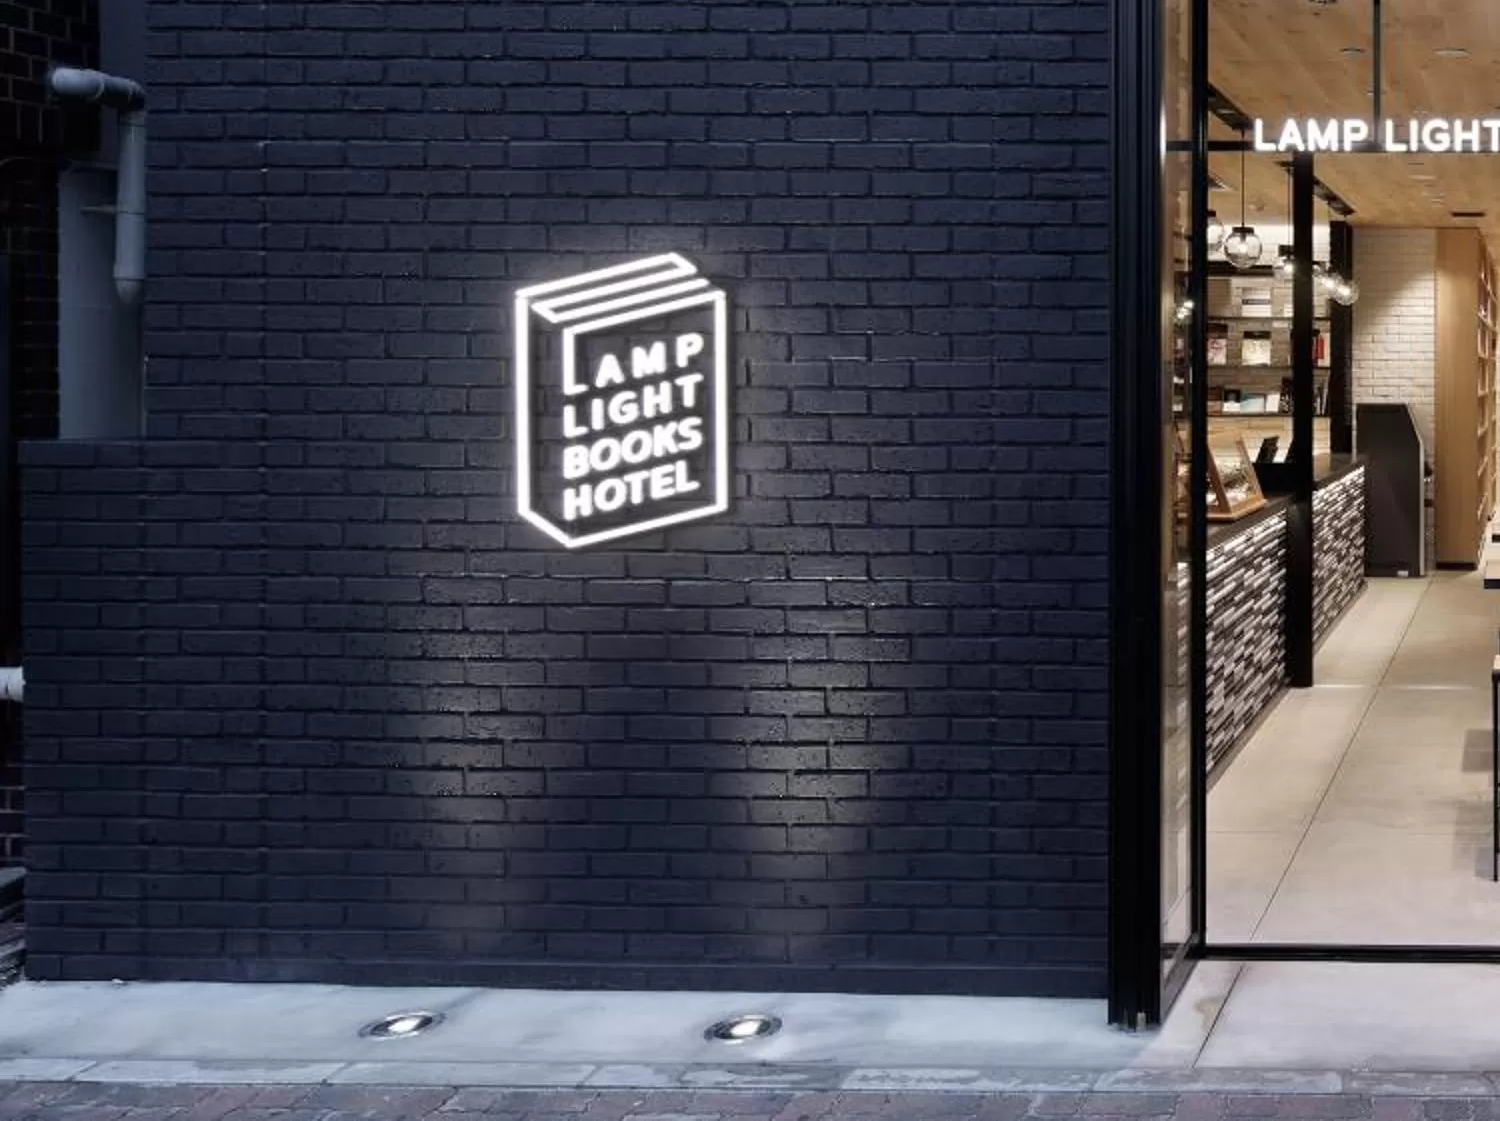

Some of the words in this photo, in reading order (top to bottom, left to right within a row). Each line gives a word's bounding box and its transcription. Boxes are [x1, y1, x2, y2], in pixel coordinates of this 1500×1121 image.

[1255, 118, 1369, 152] LAMP
[563, 332, 705, 395] LAMP
[563, 373, 705, 438] LIGHT
[563, 416, 704, 479] BOOKS
[563, 459, 700, 521] HOTEL
